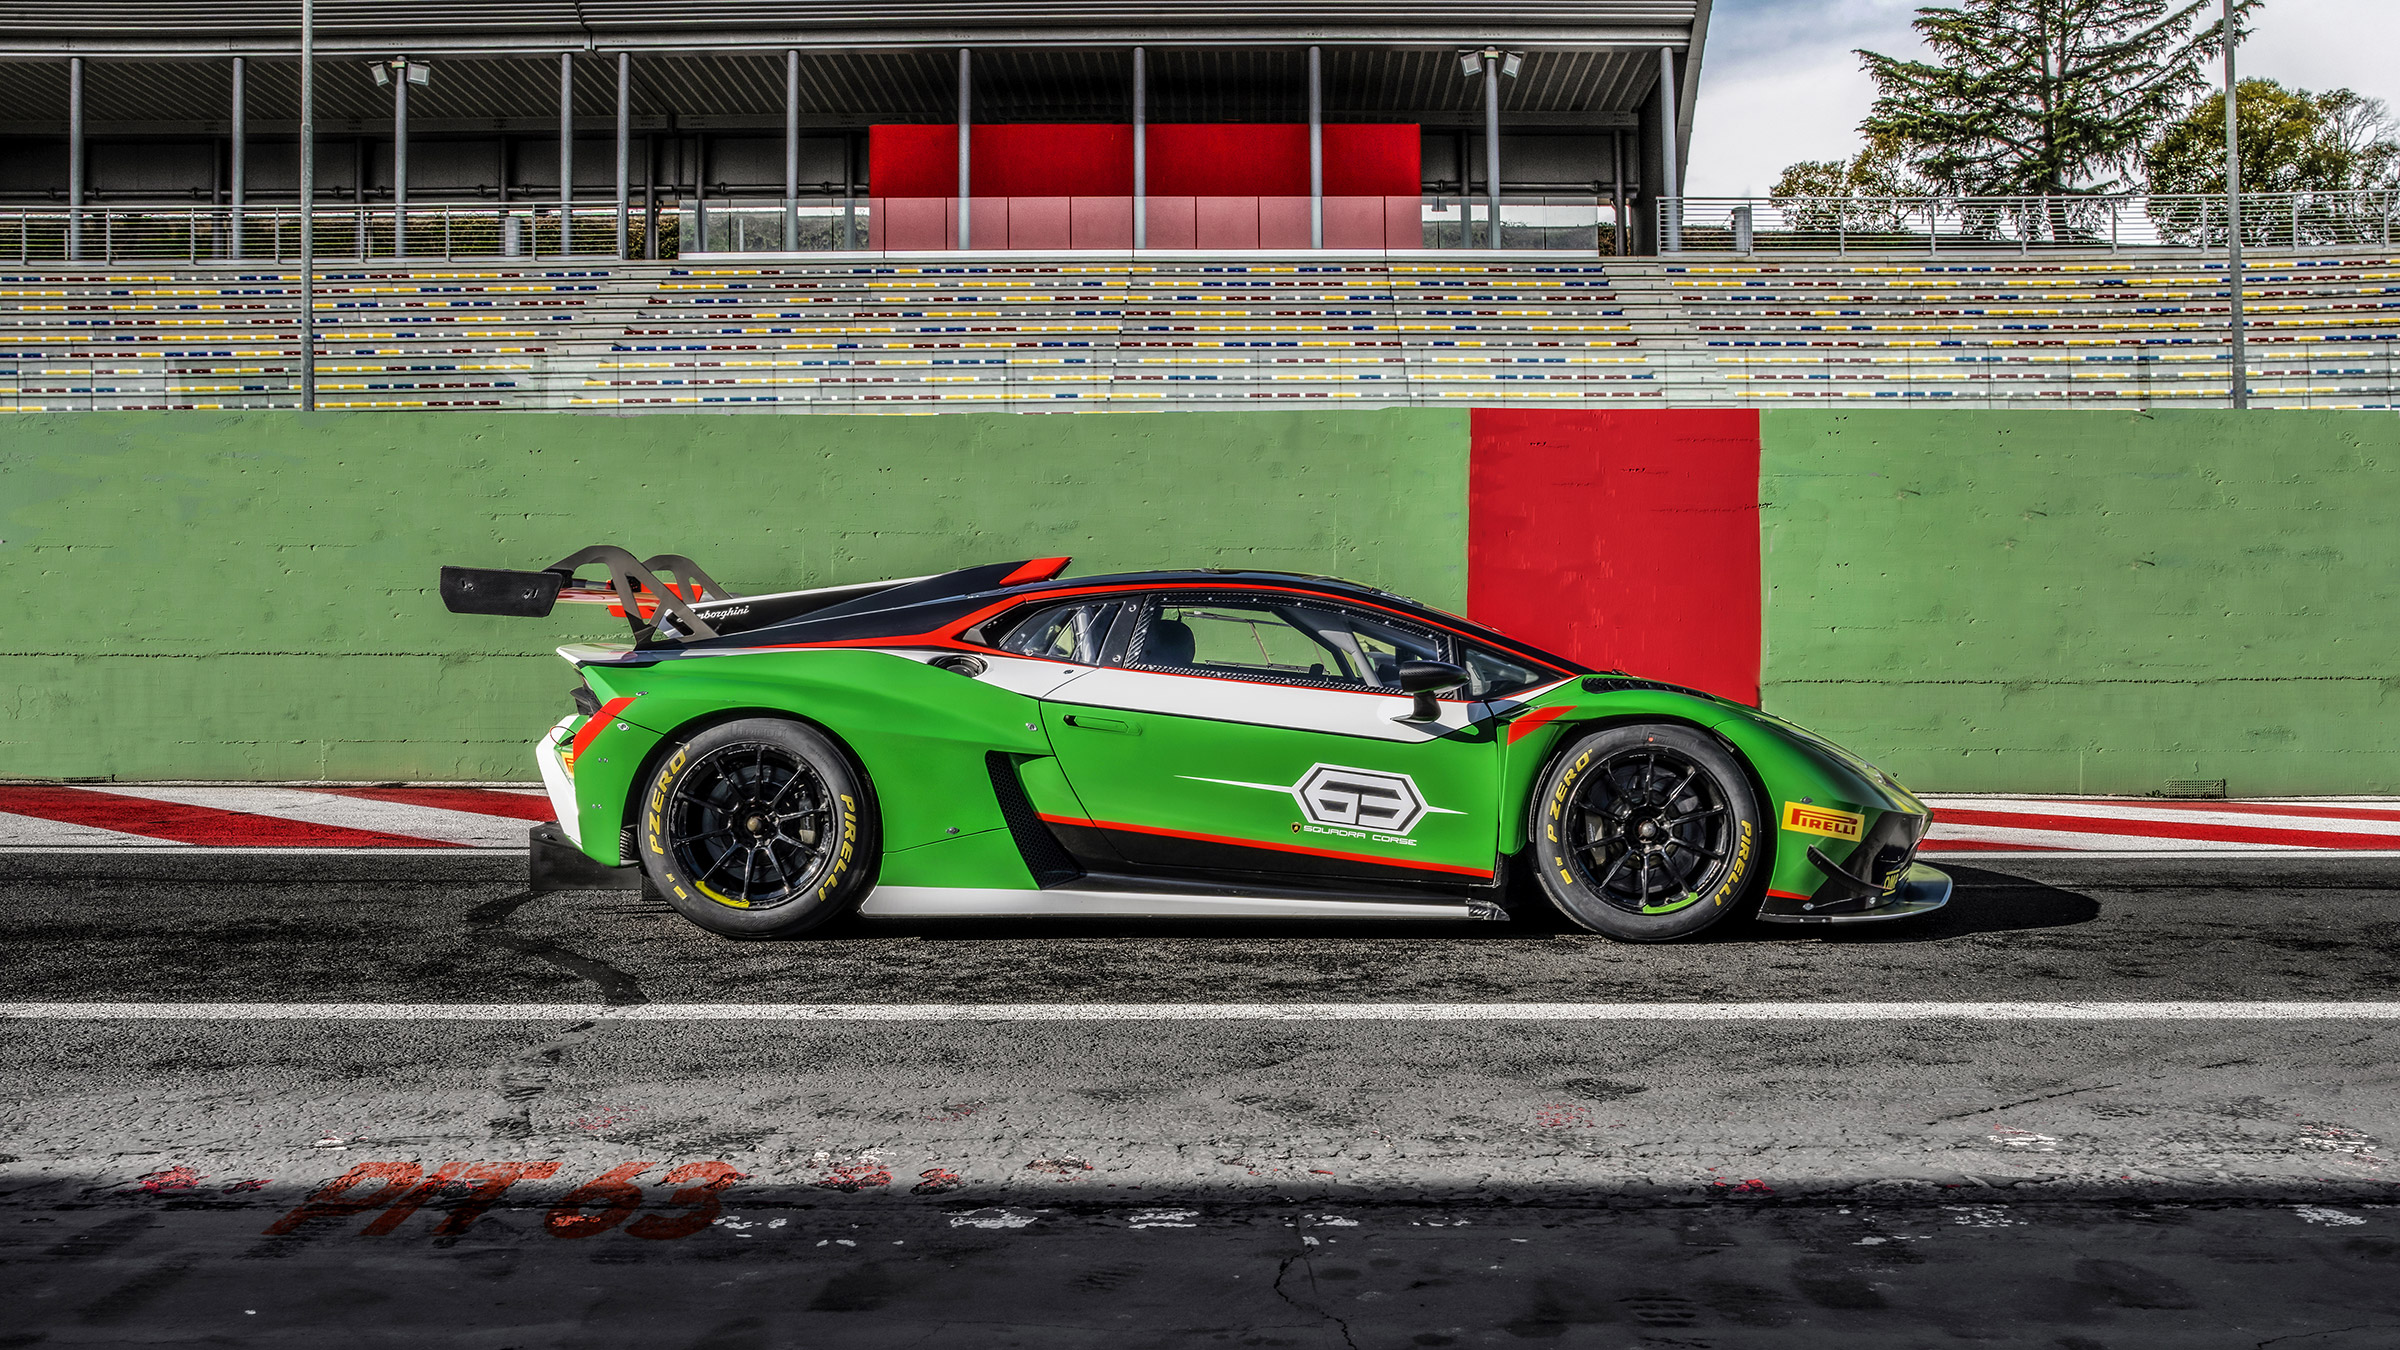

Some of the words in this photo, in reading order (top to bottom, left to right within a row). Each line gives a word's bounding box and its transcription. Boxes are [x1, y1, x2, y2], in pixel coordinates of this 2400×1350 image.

[675, 605, 750, 623] mborghini
[818, 793, 857, 902] PIRELLI
[1303, 825, 1366, 840] SQUADRA
[1371, 834, 1418, 847] CORSE
[1791, 808, 1858, 836] PIRELLI
[1714, 819, 1752, 907] PIRELLI
[260, 1161, 564, 1236] PIT
[544, 1161, 740, 1240] 63
